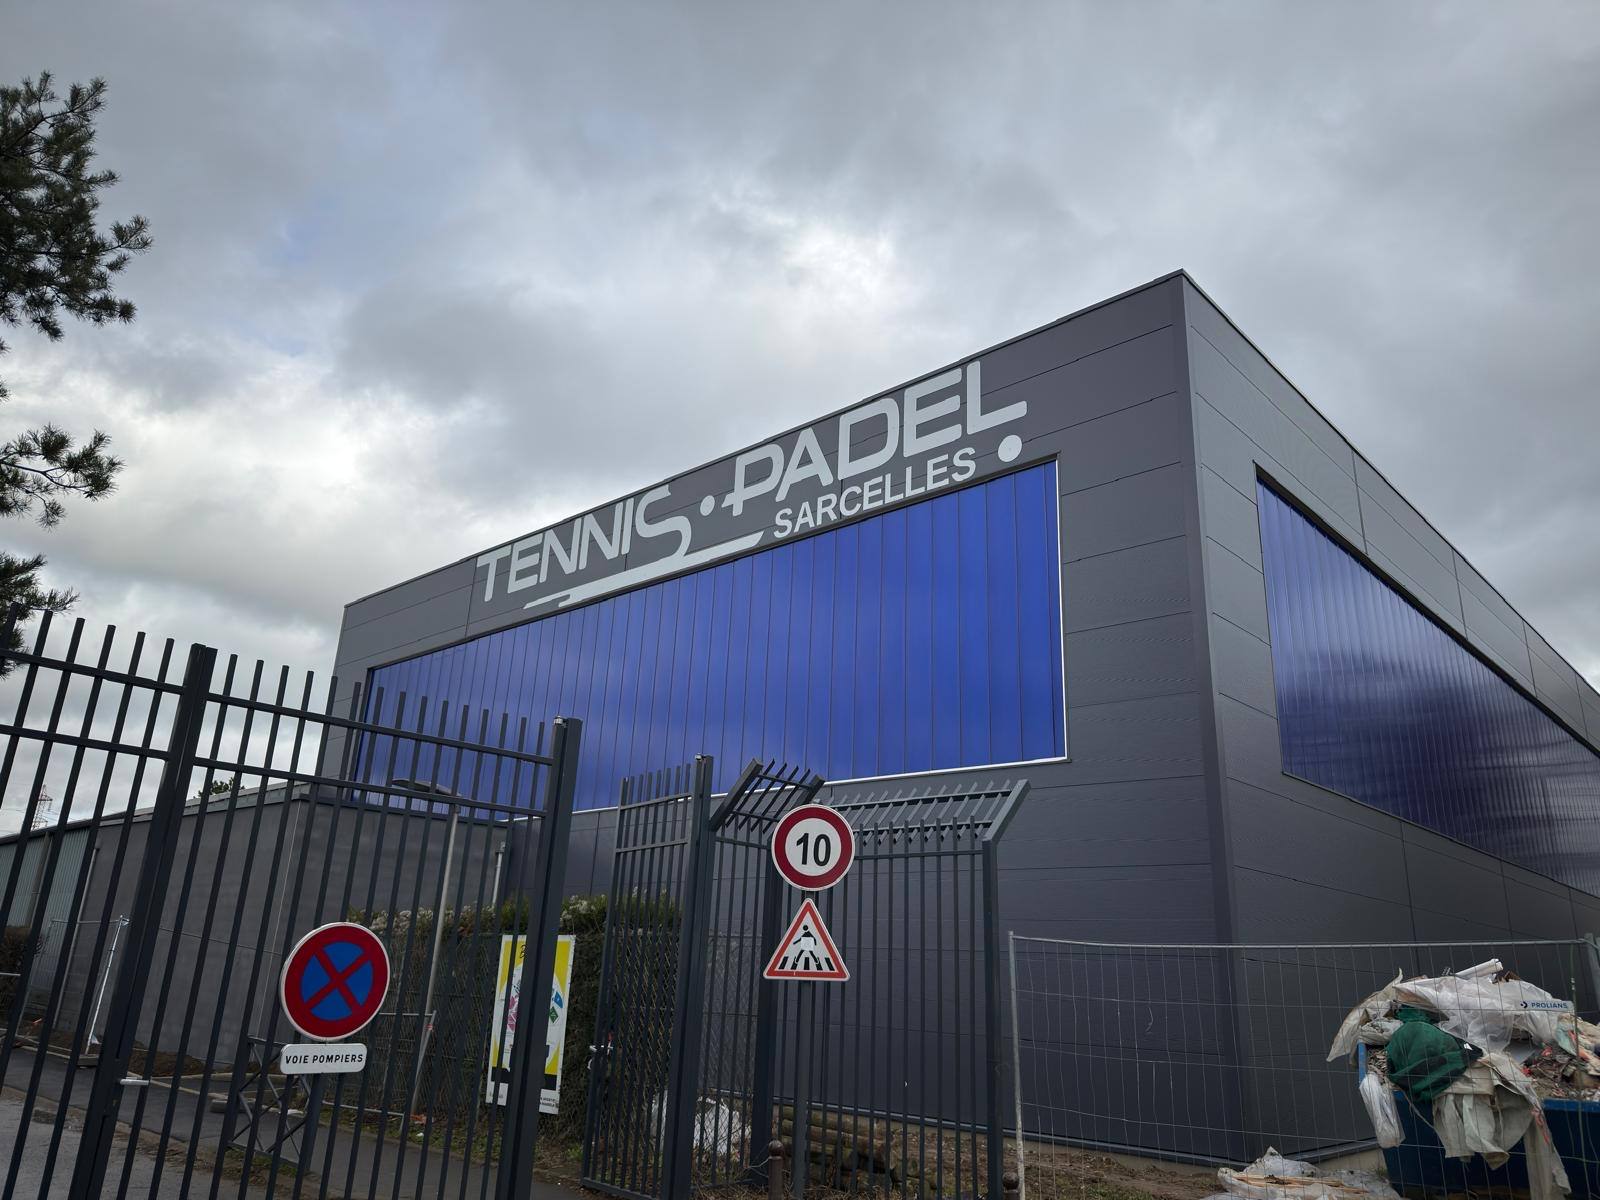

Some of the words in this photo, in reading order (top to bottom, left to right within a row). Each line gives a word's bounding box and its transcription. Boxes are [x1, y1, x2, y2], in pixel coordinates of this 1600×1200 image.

[477, 485, 692, 603] TENNIS
[722, 361, 1027, 516] PADEL
[773, 446, 977, 538] SARCELLES
[796, 832, 831, 867] 10
[285, 1055, 309, 1064] VOIE
[312, 1054, 363, 1064] POMPIERS
